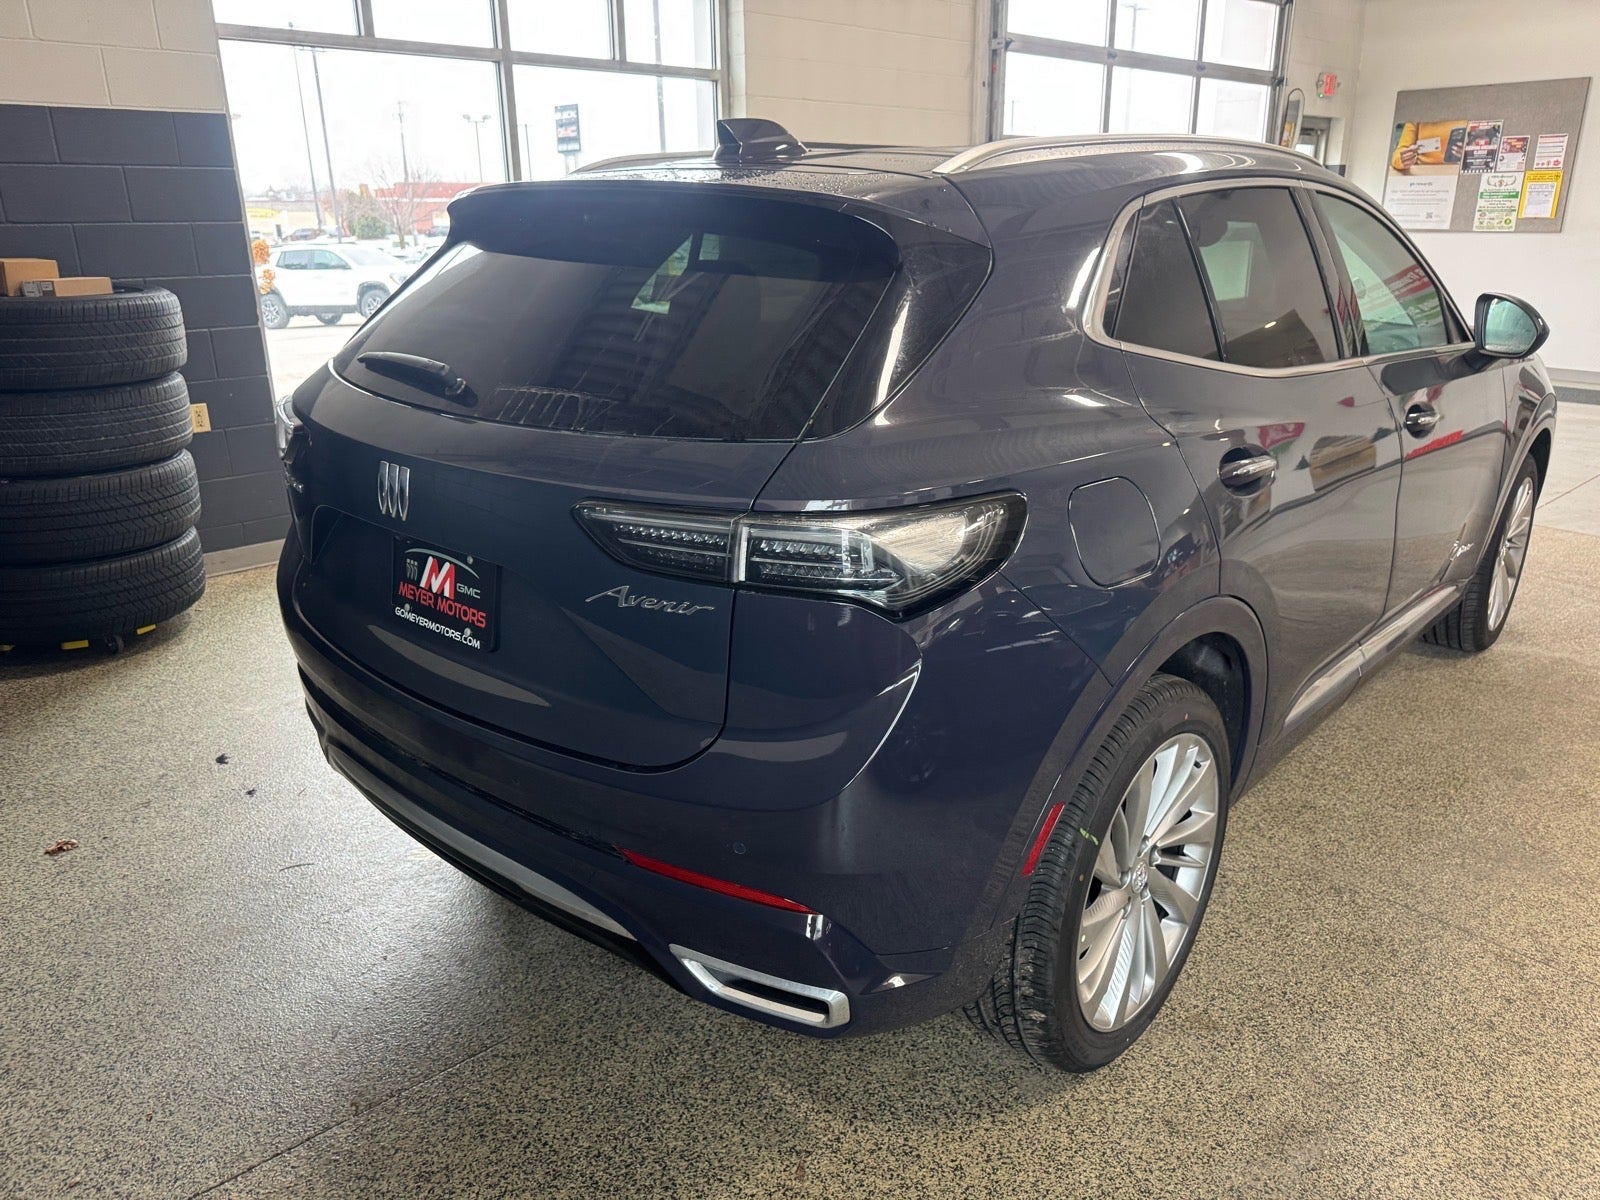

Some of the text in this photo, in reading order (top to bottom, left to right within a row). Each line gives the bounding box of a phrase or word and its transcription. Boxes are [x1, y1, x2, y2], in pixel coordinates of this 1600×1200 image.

[399, 582, 486, 628] MEYER MOTORS
[456, 583, 480, 598] GMC
[585, 586, 715, 615] Avenir
[395, 607, 480, 650] GOMEYERMOTORS.COM
